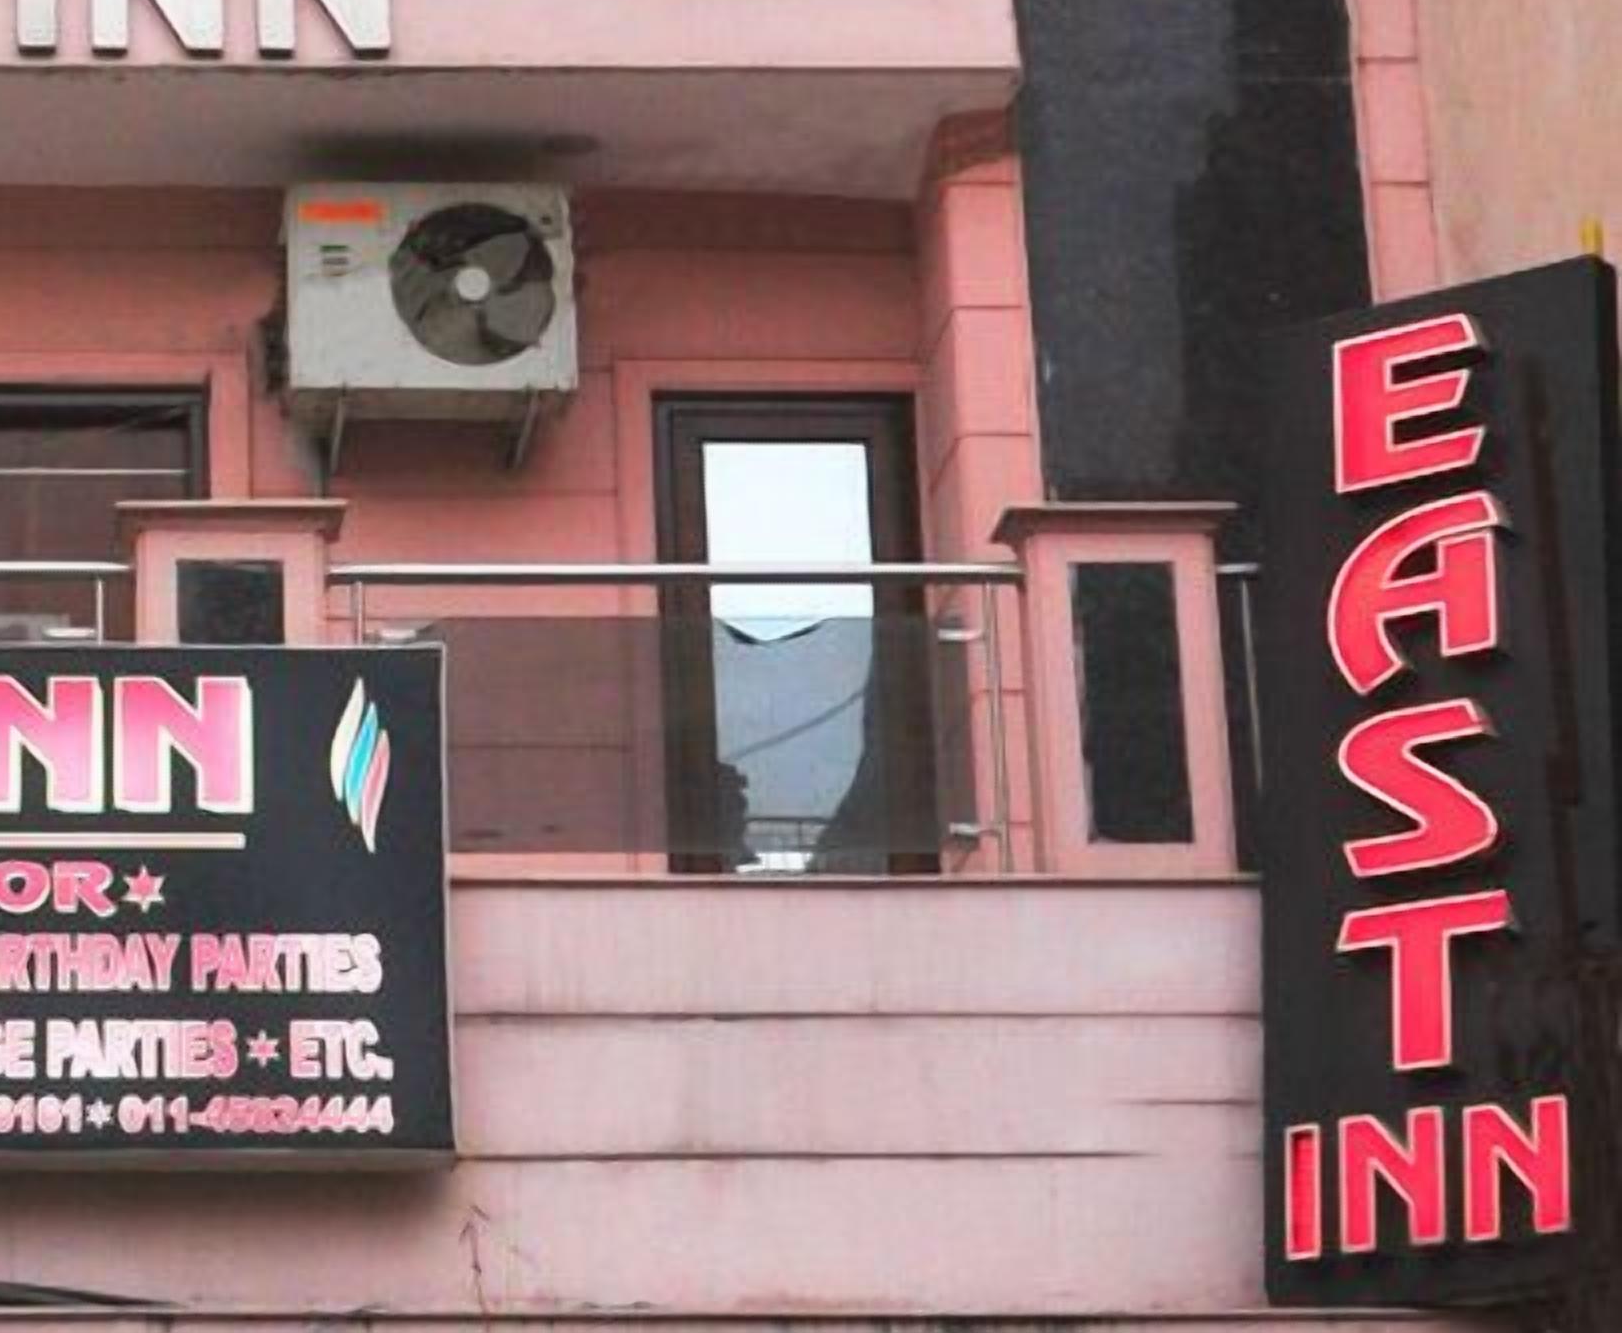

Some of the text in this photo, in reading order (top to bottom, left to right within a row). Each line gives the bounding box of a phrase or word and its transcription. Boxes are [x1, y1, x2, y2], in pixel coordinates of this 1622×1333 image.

[1327, 313, 1509, 1070] EAST
[191, 933, 383, 993] PARTIES
[46, 1019, 238, 1079] PARTIES
[289, 1019, 394, 1080] ETC.
[1285, 1095, 1570, 1260] INN
